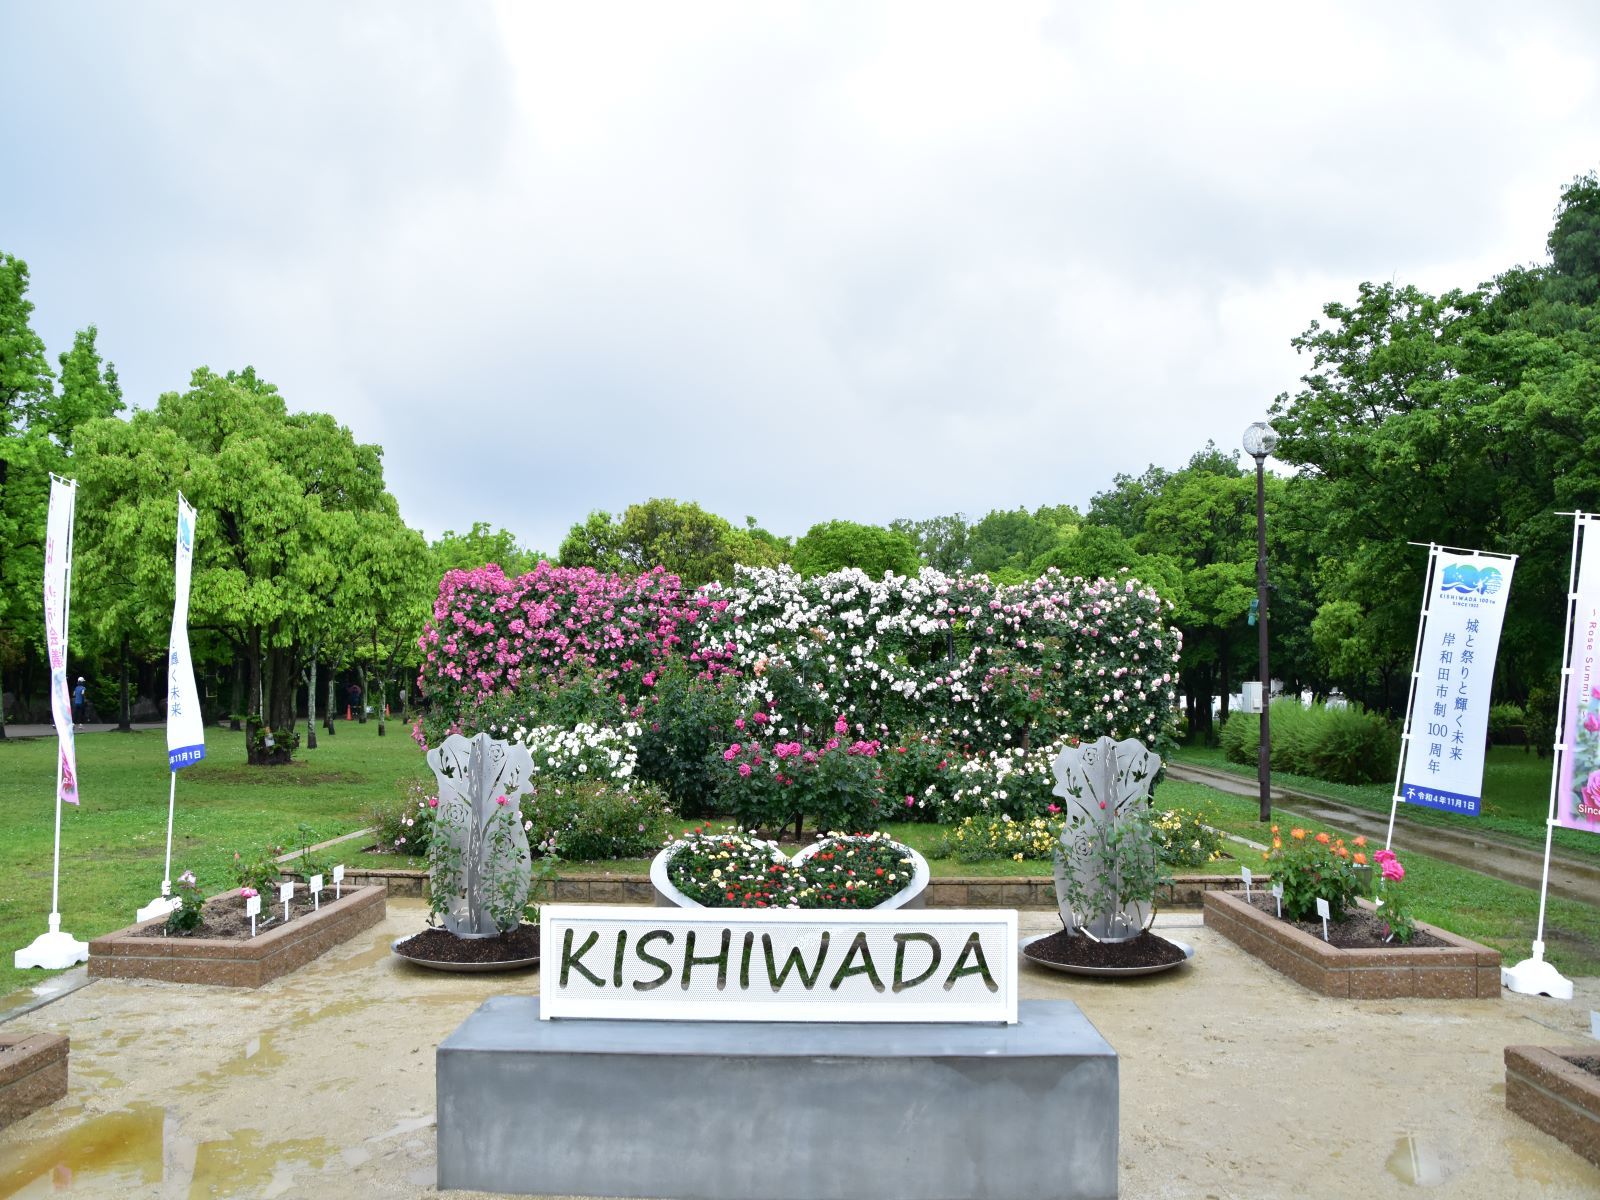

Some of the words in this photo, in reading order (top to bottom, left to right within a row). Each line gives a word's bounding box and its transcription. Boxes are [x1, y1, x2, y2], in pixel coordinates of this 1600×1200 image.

[1586, 621, 1597, 651] Rose
[1449, 618, 1479, 761] 城と祭りと輝く未来
[1581, 657, 1594, 703] Summit
[1578, 803, 1600, 816] Sinc
[558, 927, 999, 994] KISHIWADA
